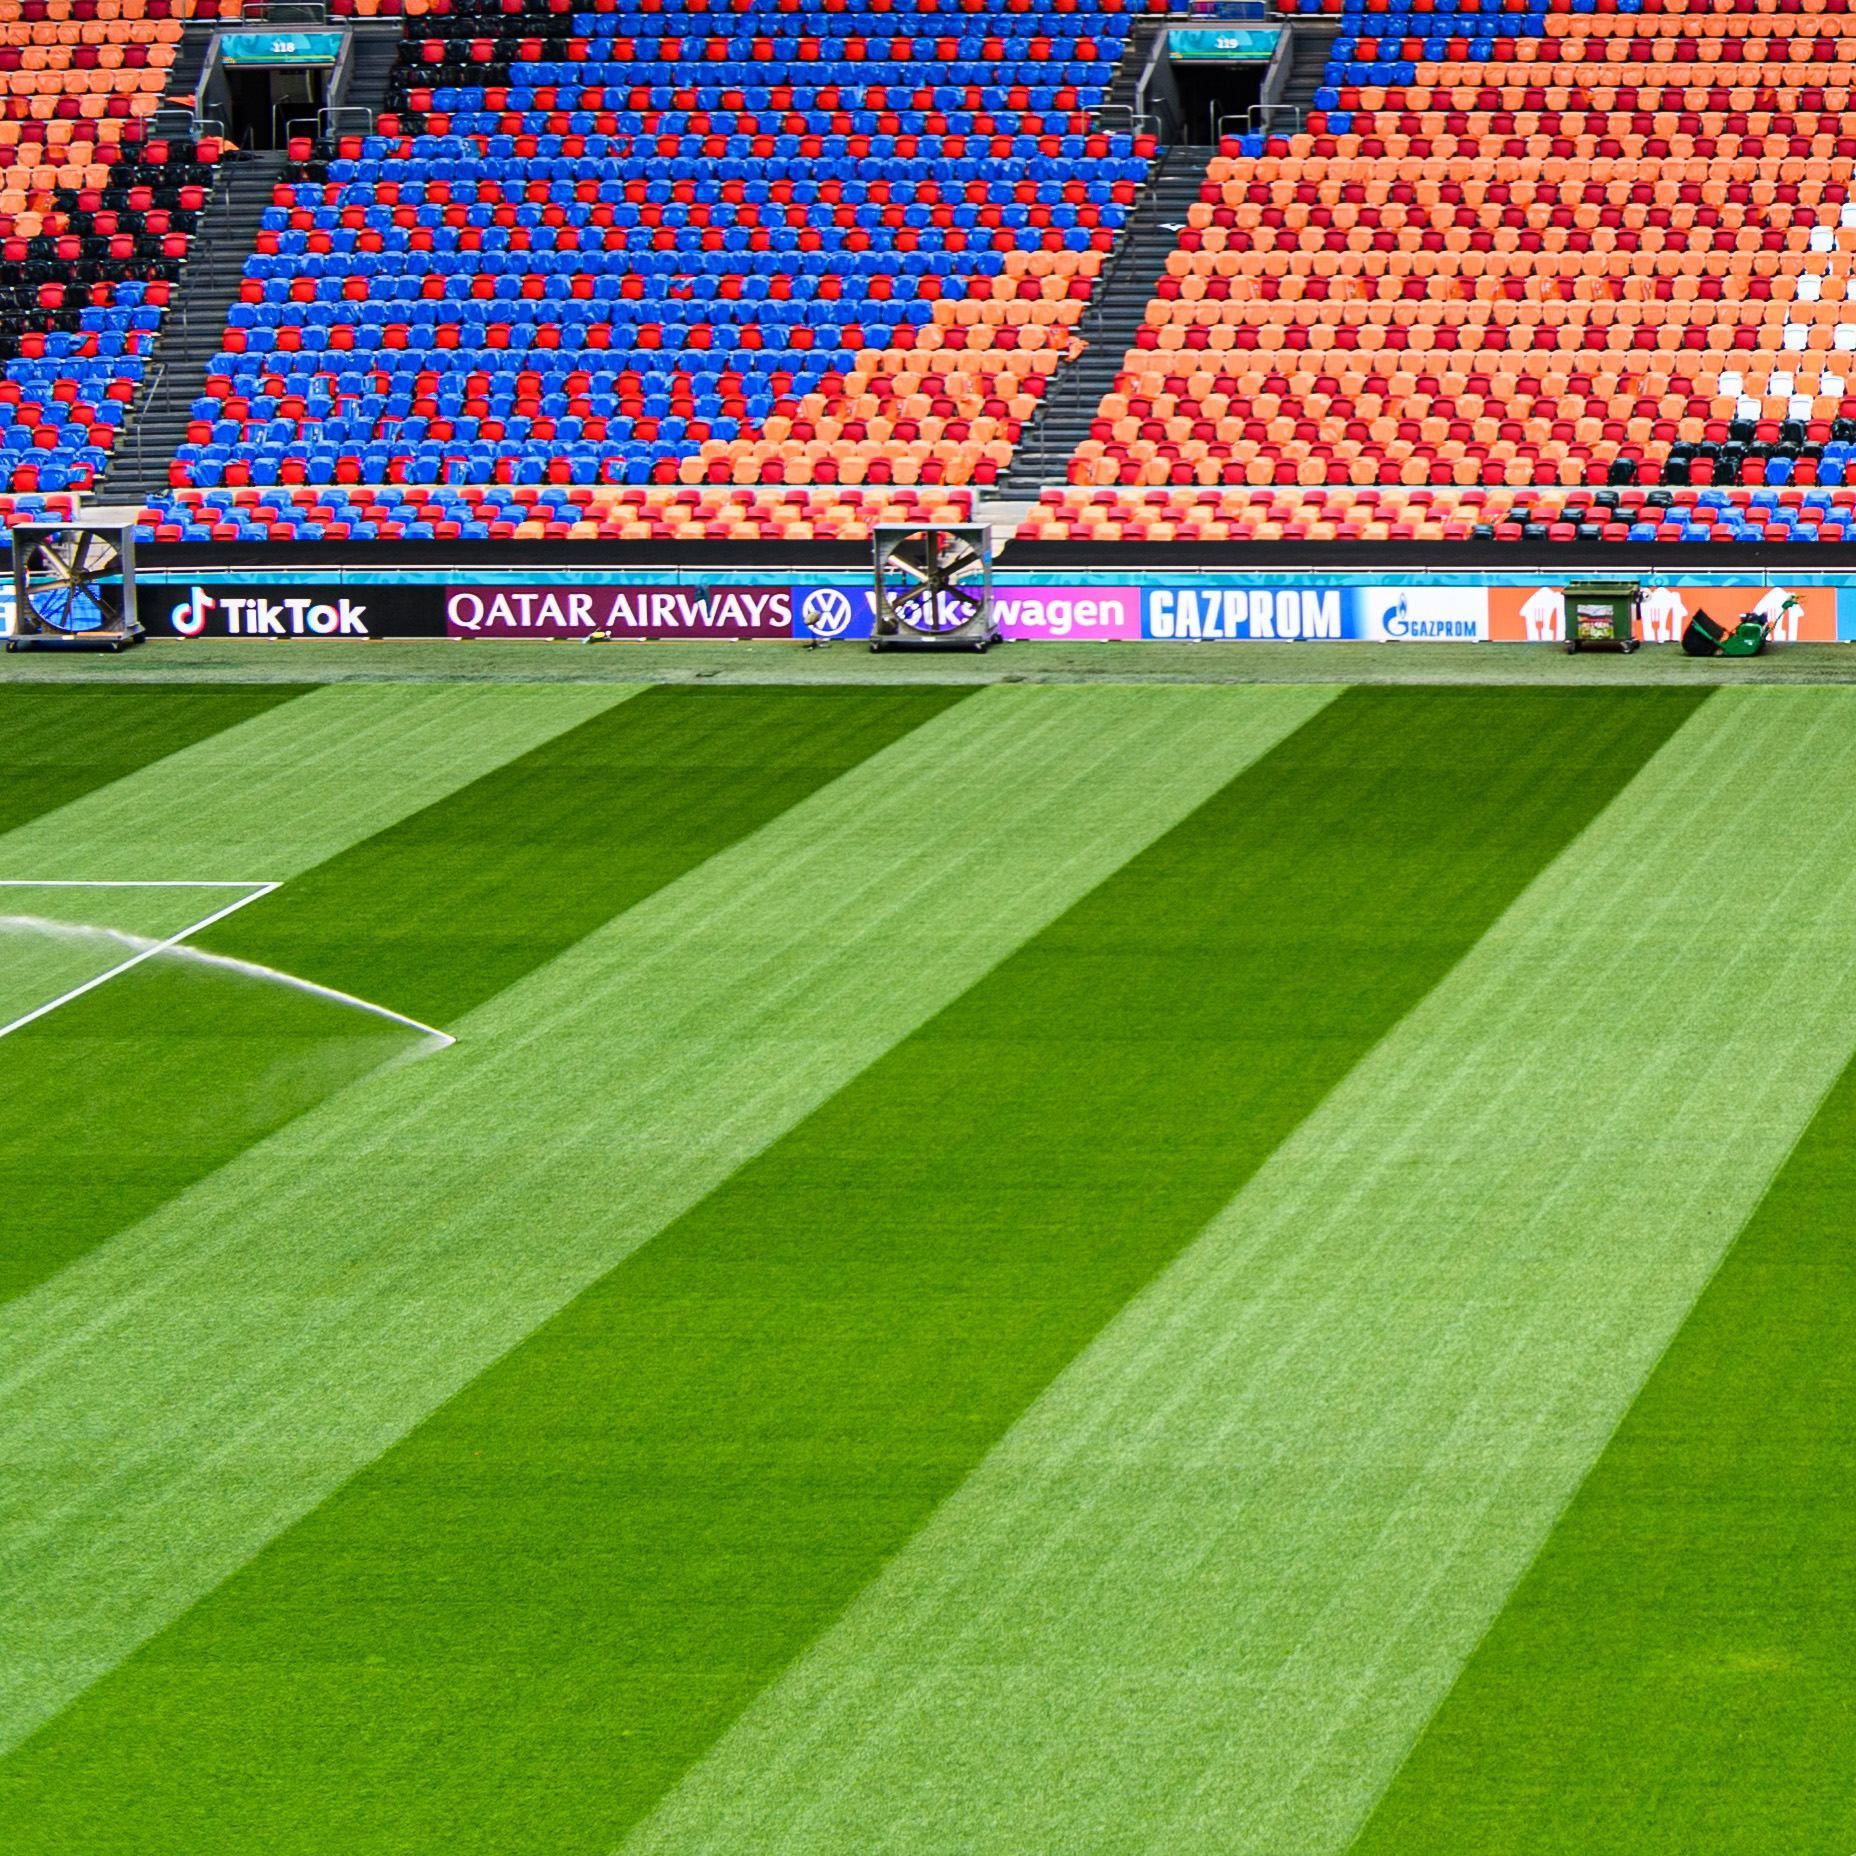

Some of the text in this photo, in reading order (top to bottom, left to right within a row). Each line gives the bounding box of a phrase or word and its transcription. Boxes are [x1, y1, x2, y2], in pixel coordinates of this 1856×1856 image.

[220, 598, 368, 634] TikTok
[448, 593, 791, 630] QATAR AIRWAYS
[1150, 590, 1340, 638] GAZPROM
[1411, 620, 1477, 637] GAZPROM
